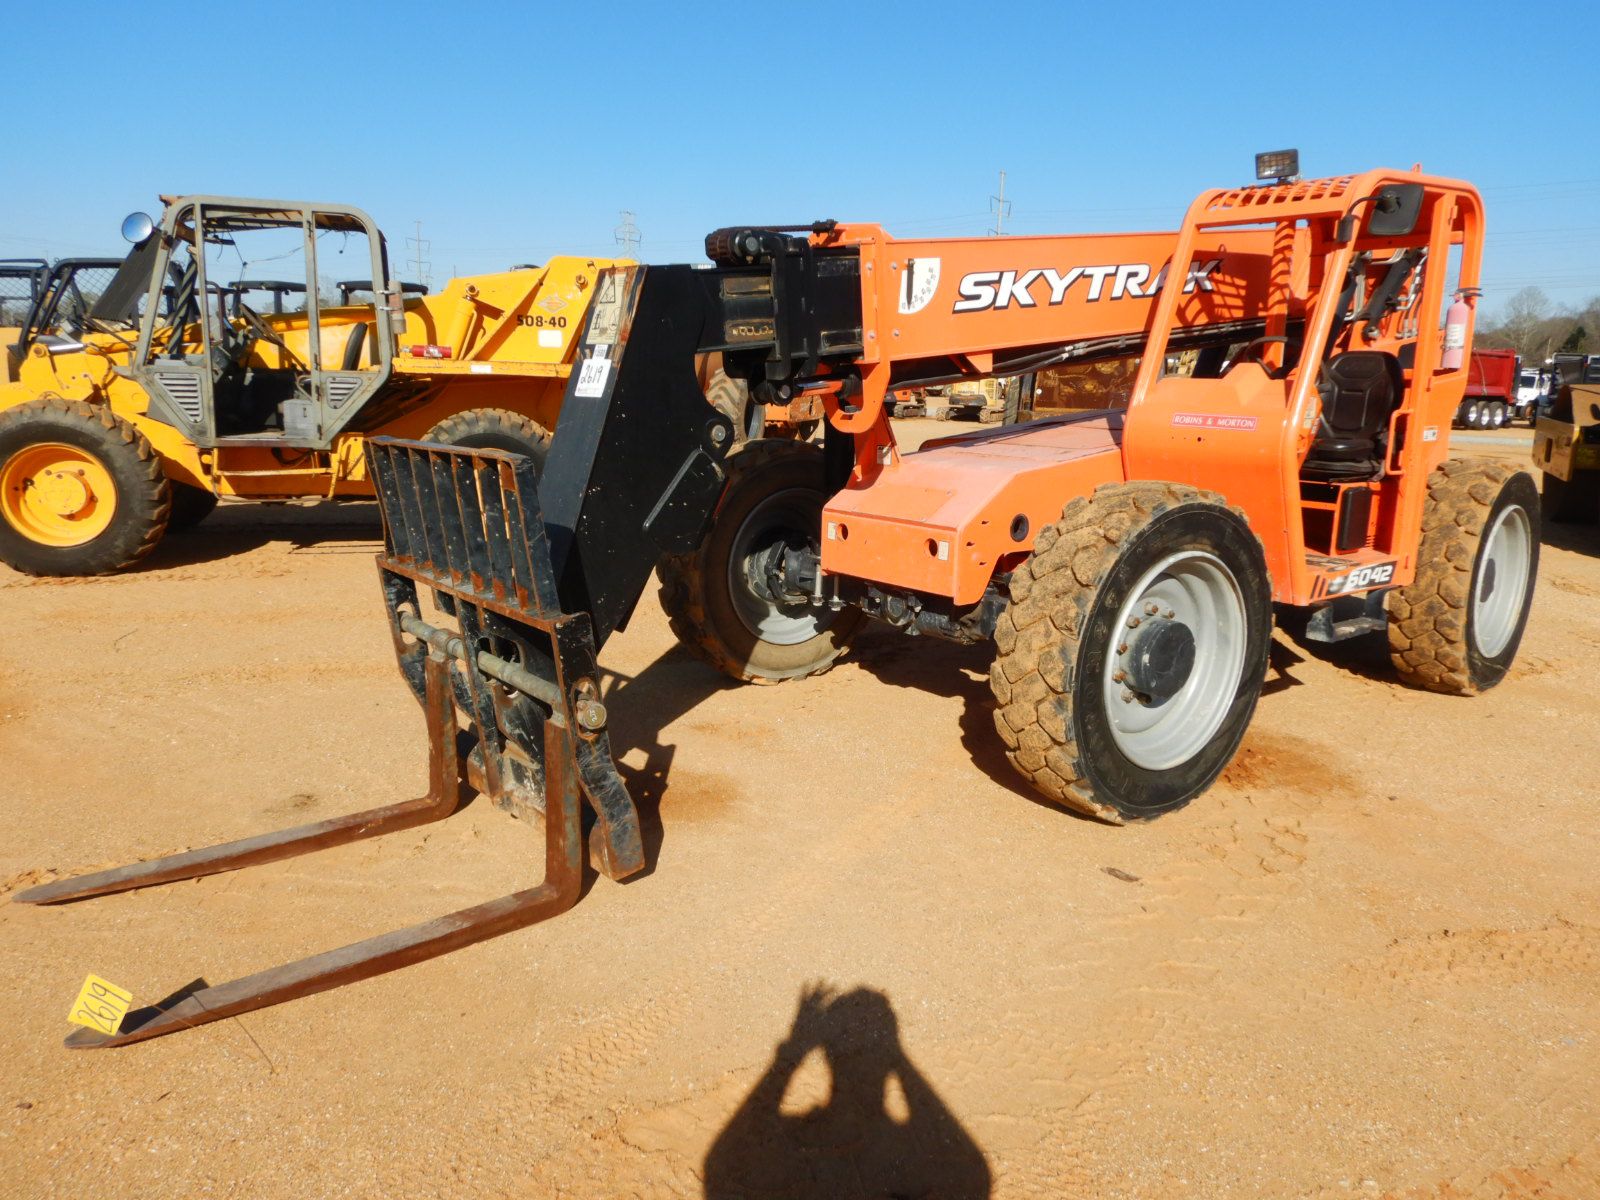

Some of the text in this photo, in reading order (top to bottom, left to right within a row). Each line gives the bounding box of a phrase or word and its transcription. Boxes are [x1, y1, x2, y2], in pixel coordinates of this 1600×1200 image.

[580, 365, 604, 384] 2619
[1174, 415, 1254, 429] ROBINS & MORTON
[1348, 565, 1393, 588] 6042
[78, 982, 131, 1032] 2619
